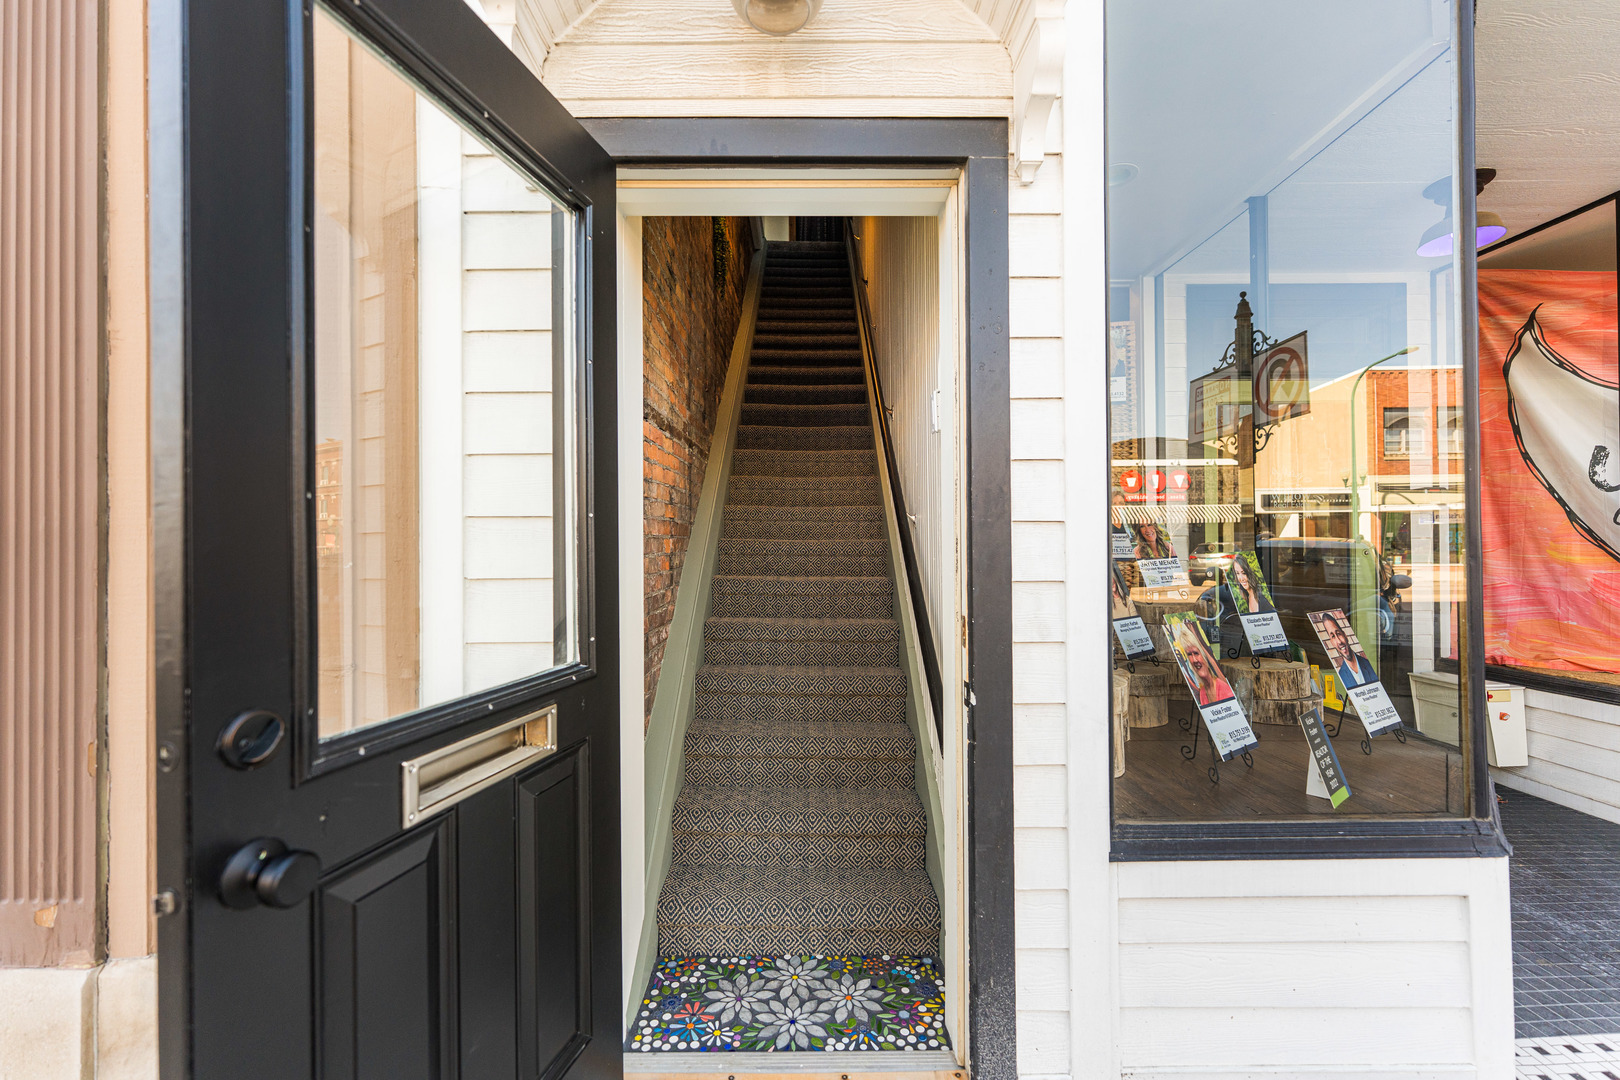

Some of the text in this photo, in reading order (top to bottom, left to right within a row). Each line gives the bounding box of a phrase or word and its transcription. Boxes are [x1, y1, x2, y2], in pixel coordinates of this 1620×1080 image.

[1141, 560, 1159, 568] JAYNE
[1210, 705, 1233, 717] Vickie Foster
[1325, 767, 1335, 778] YEAR
